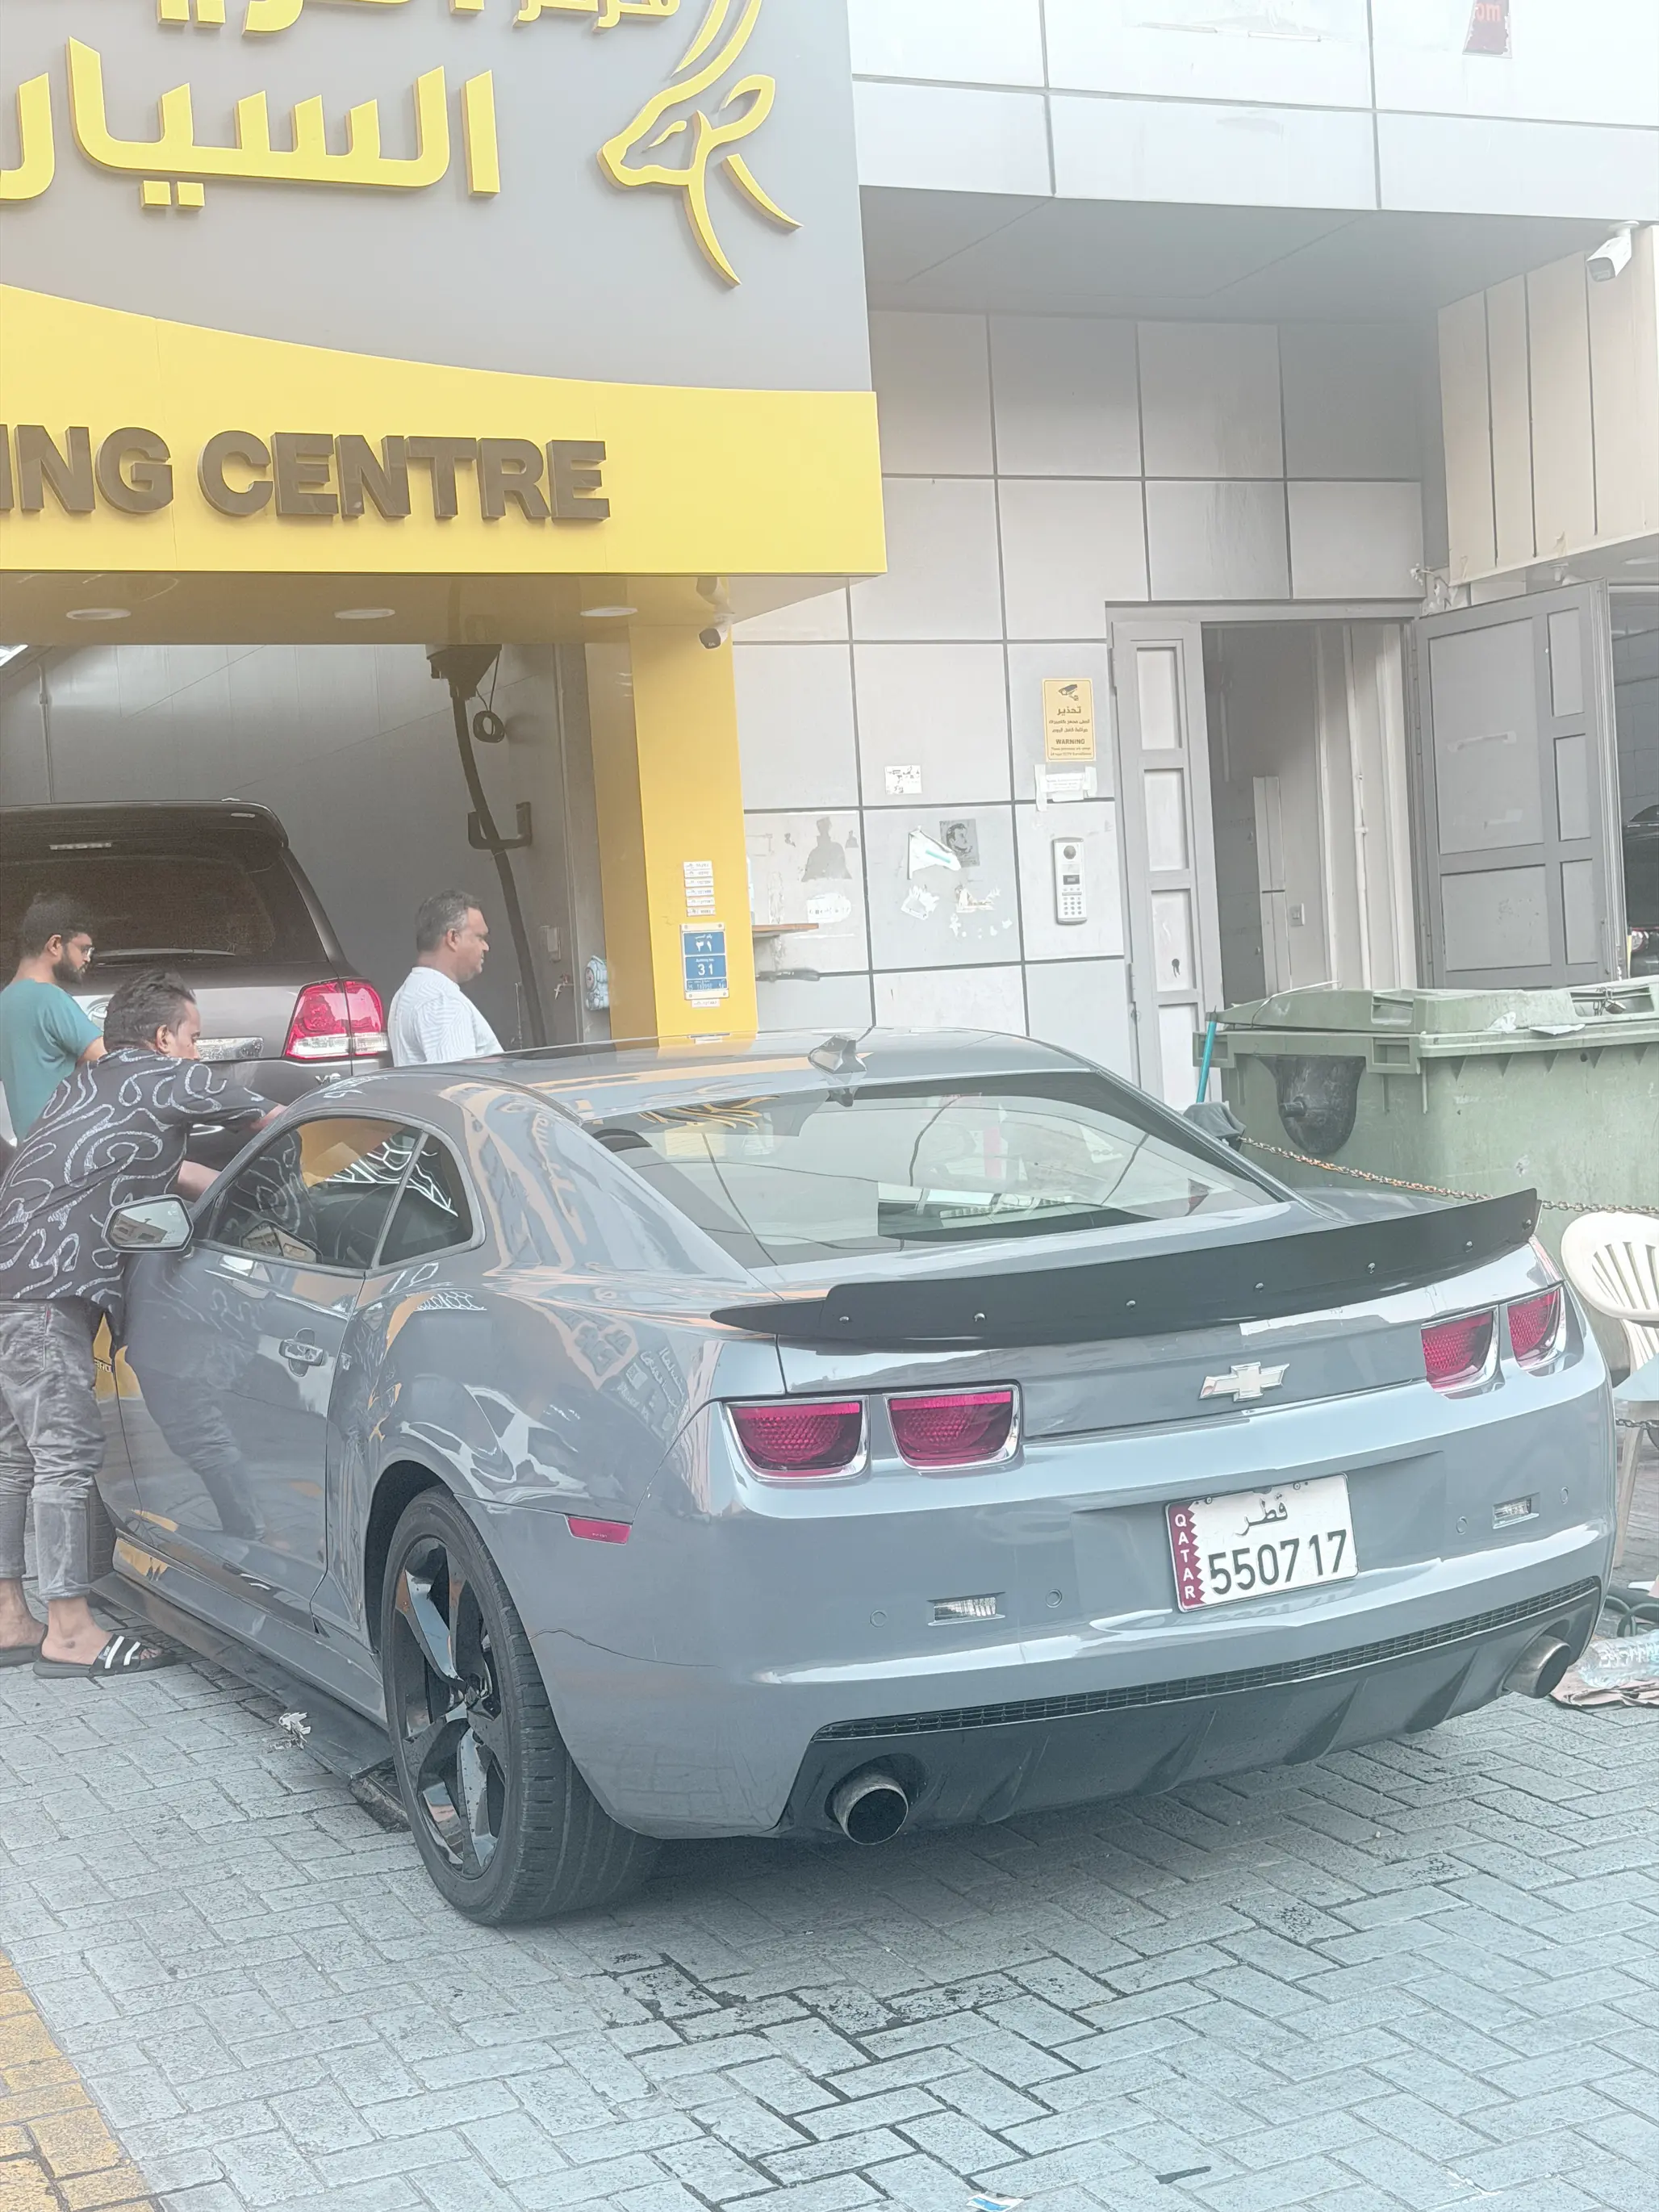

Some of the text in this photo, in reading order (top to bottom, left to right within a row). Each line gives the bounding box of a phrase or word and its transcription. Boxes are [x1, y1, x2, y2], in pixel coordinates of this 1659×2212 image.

[197, 429, 611, 524] CENTRE
[1057, 705, 1081, 716] تحذير
[696, 940, 712, 952] ٣١
[697, 963, 713, 976] 31
[1235, 1493, 1288, 1537] قطر
[1175, 1513, 1196, 1599] QATAR
[1208, 1528, 1347, 1595] 550717
